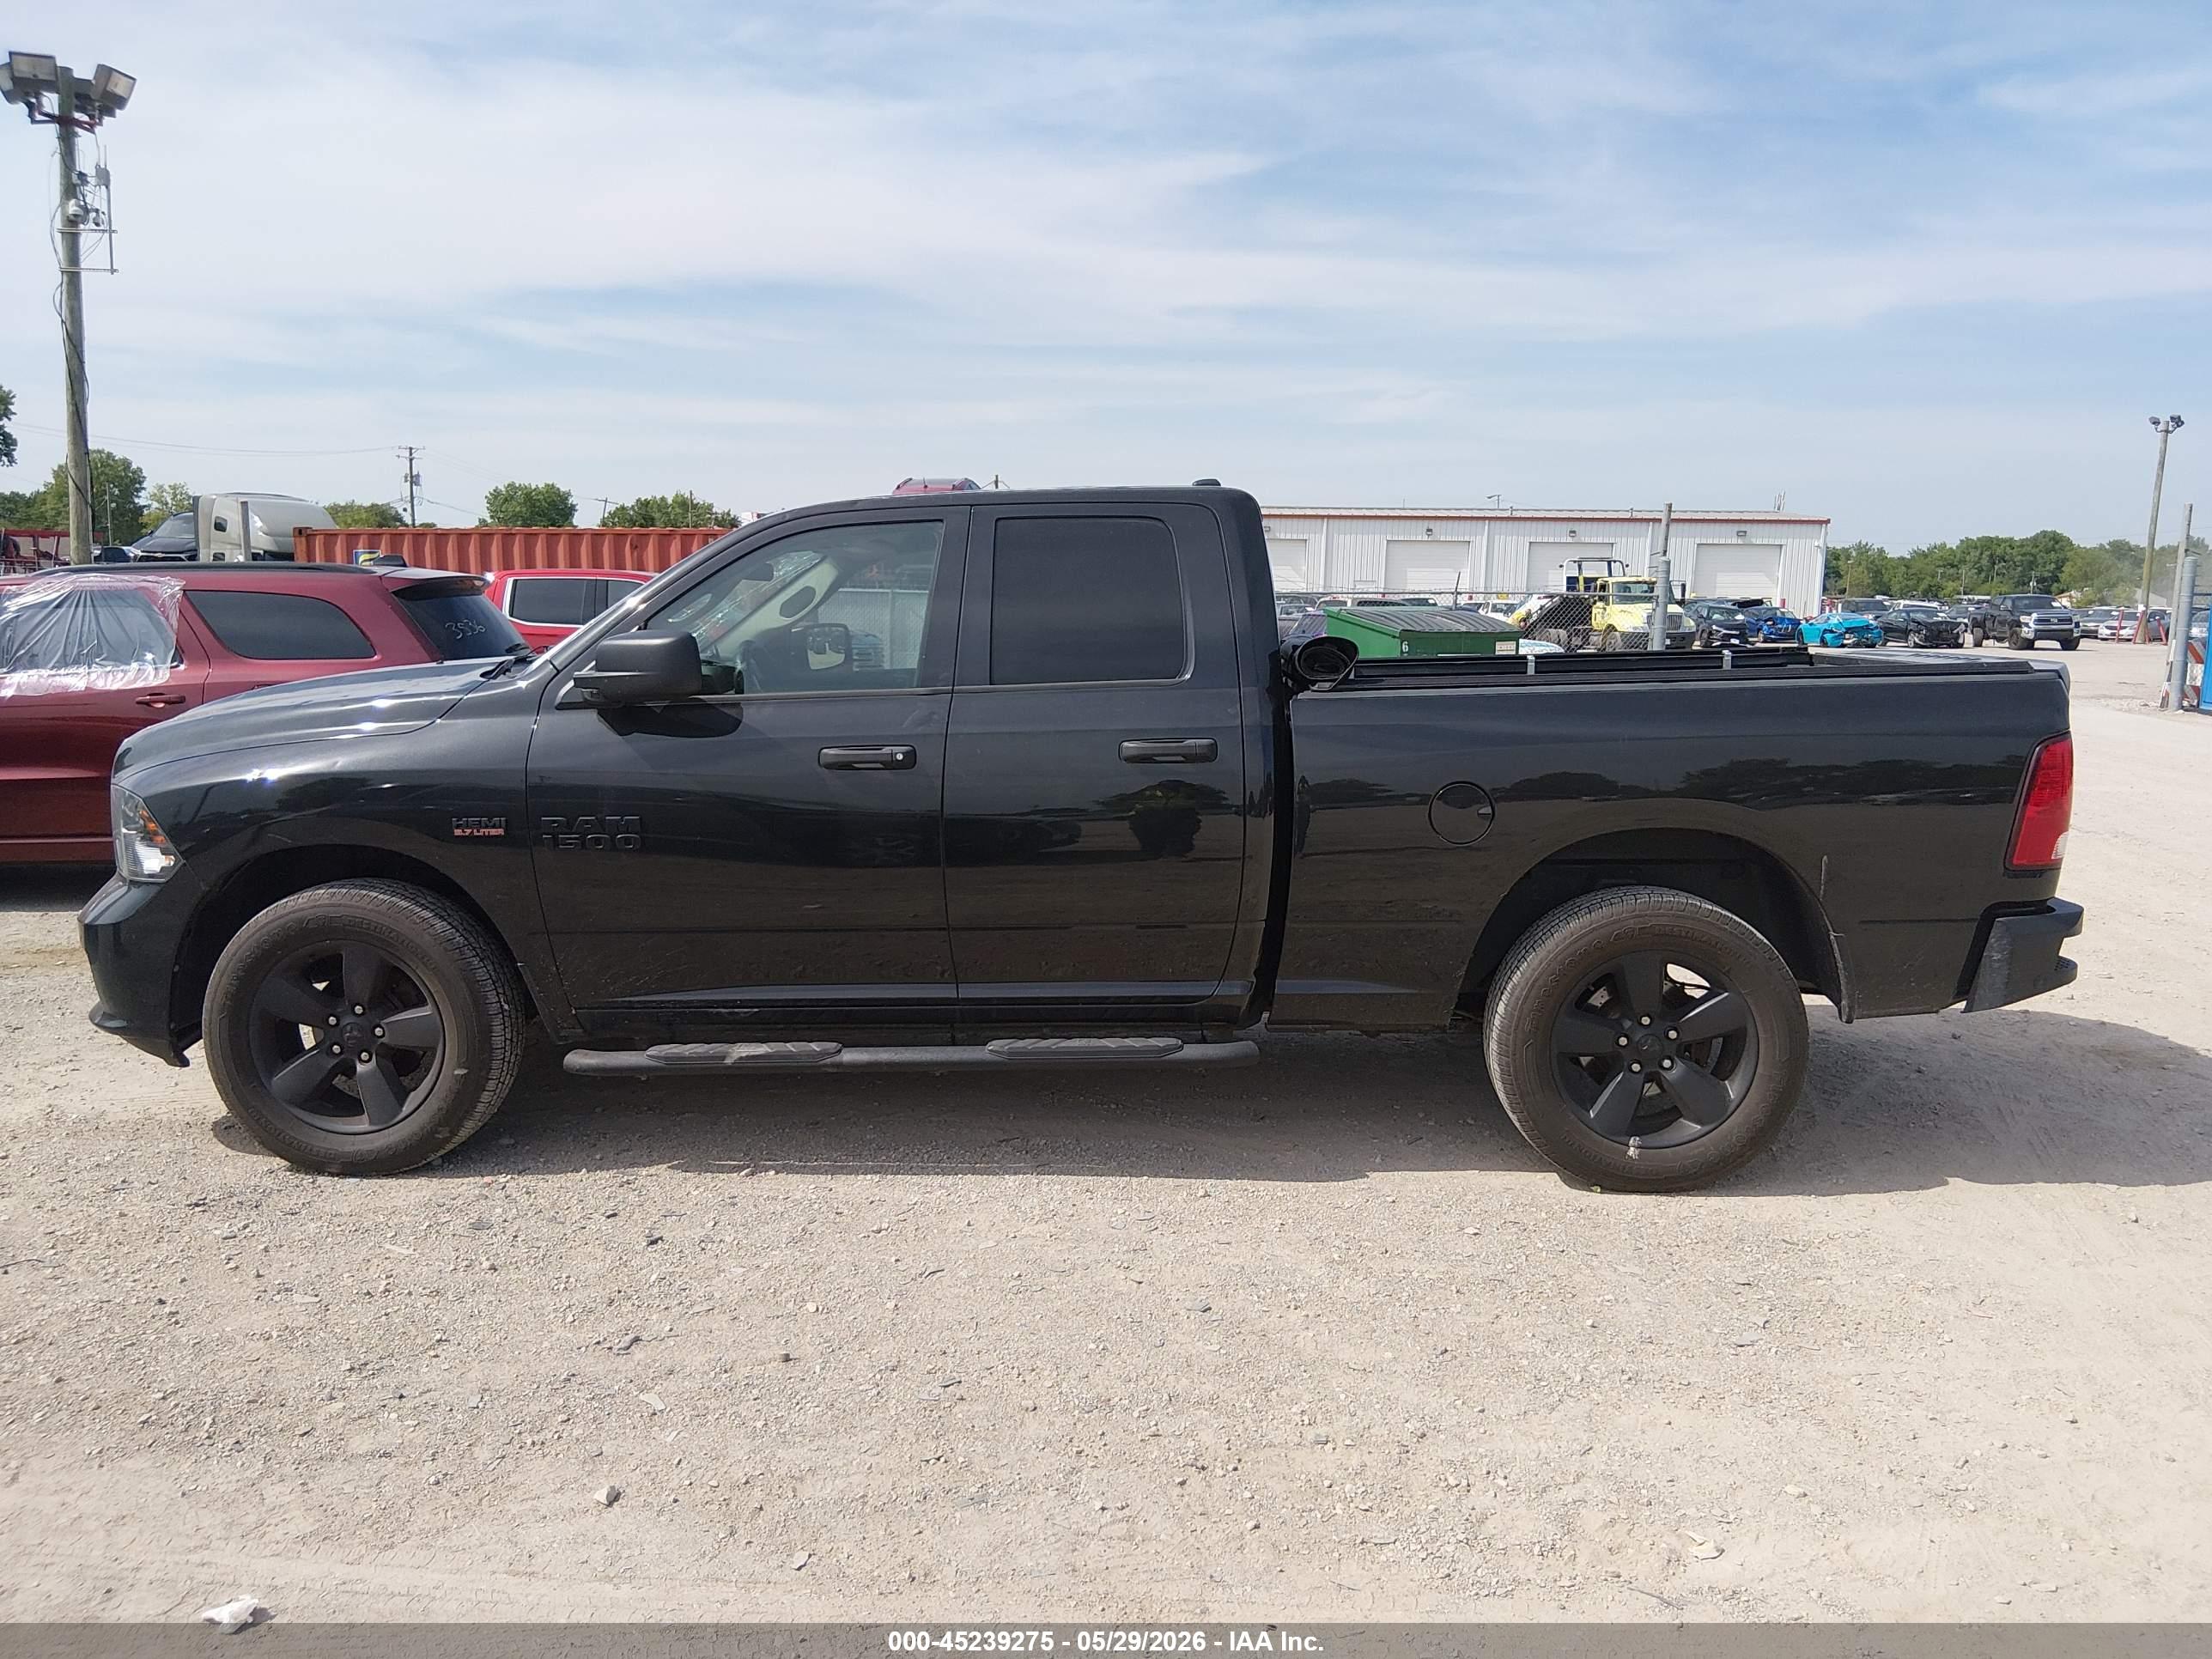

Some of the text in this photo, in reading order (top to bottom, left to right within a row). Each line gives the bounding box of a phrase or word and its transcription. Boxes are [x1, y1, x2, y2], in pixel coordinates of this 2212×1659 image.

[1401, 641, 1409, 653] 6
[452, 817, 507, 829] HEMI
[540, 816, 641, 832] RAM
[542, 834, 641, 850] 1500
